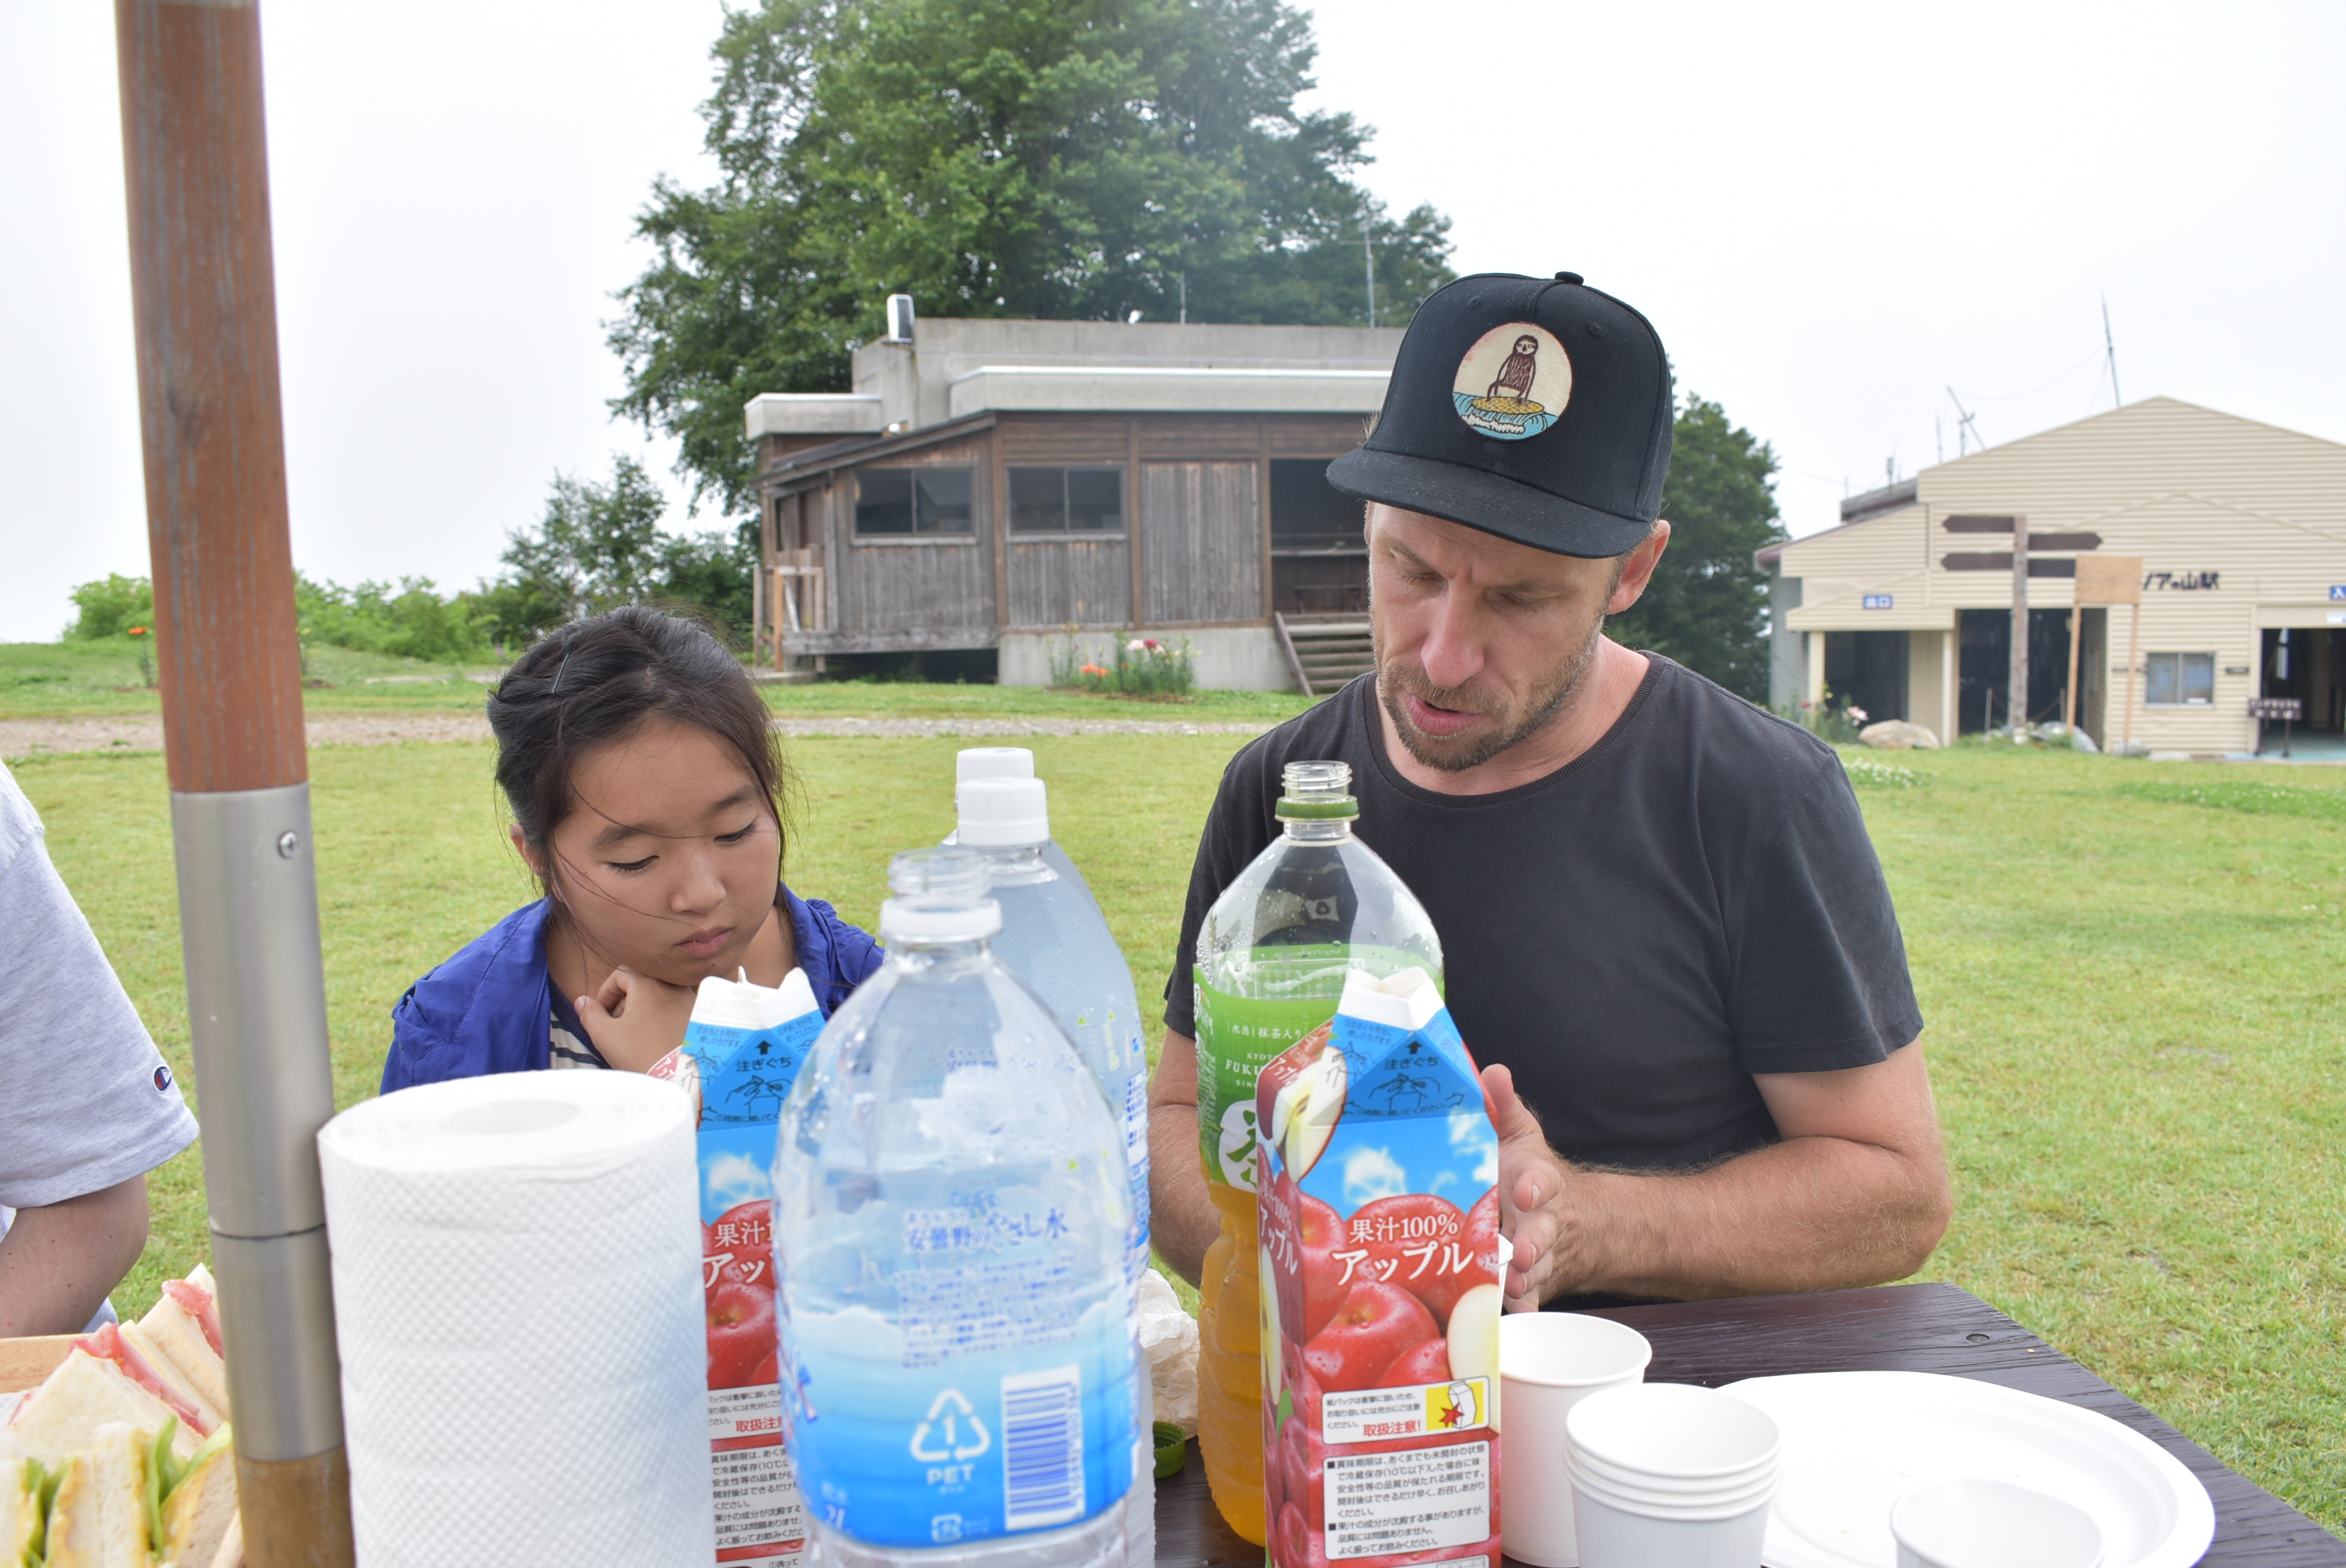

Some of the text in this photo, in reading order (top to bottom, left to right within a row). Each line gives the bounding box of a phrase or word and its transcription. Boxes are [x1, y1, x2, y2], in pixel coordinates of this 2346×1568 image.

[735, 1056, 792, 1073] 注ぎぐち
[1246, 1051, 1277, 1061] KYOT
[1384, 1055, 1439, 1071] 注ぎぐち
[1348, 1211, 1459, 1245] 果汁100%
[703, 1251, 773, 1289] アッ
[1331, 1240, 1475, 1287] アップル
[927, 1462, 975, 1485] PET
